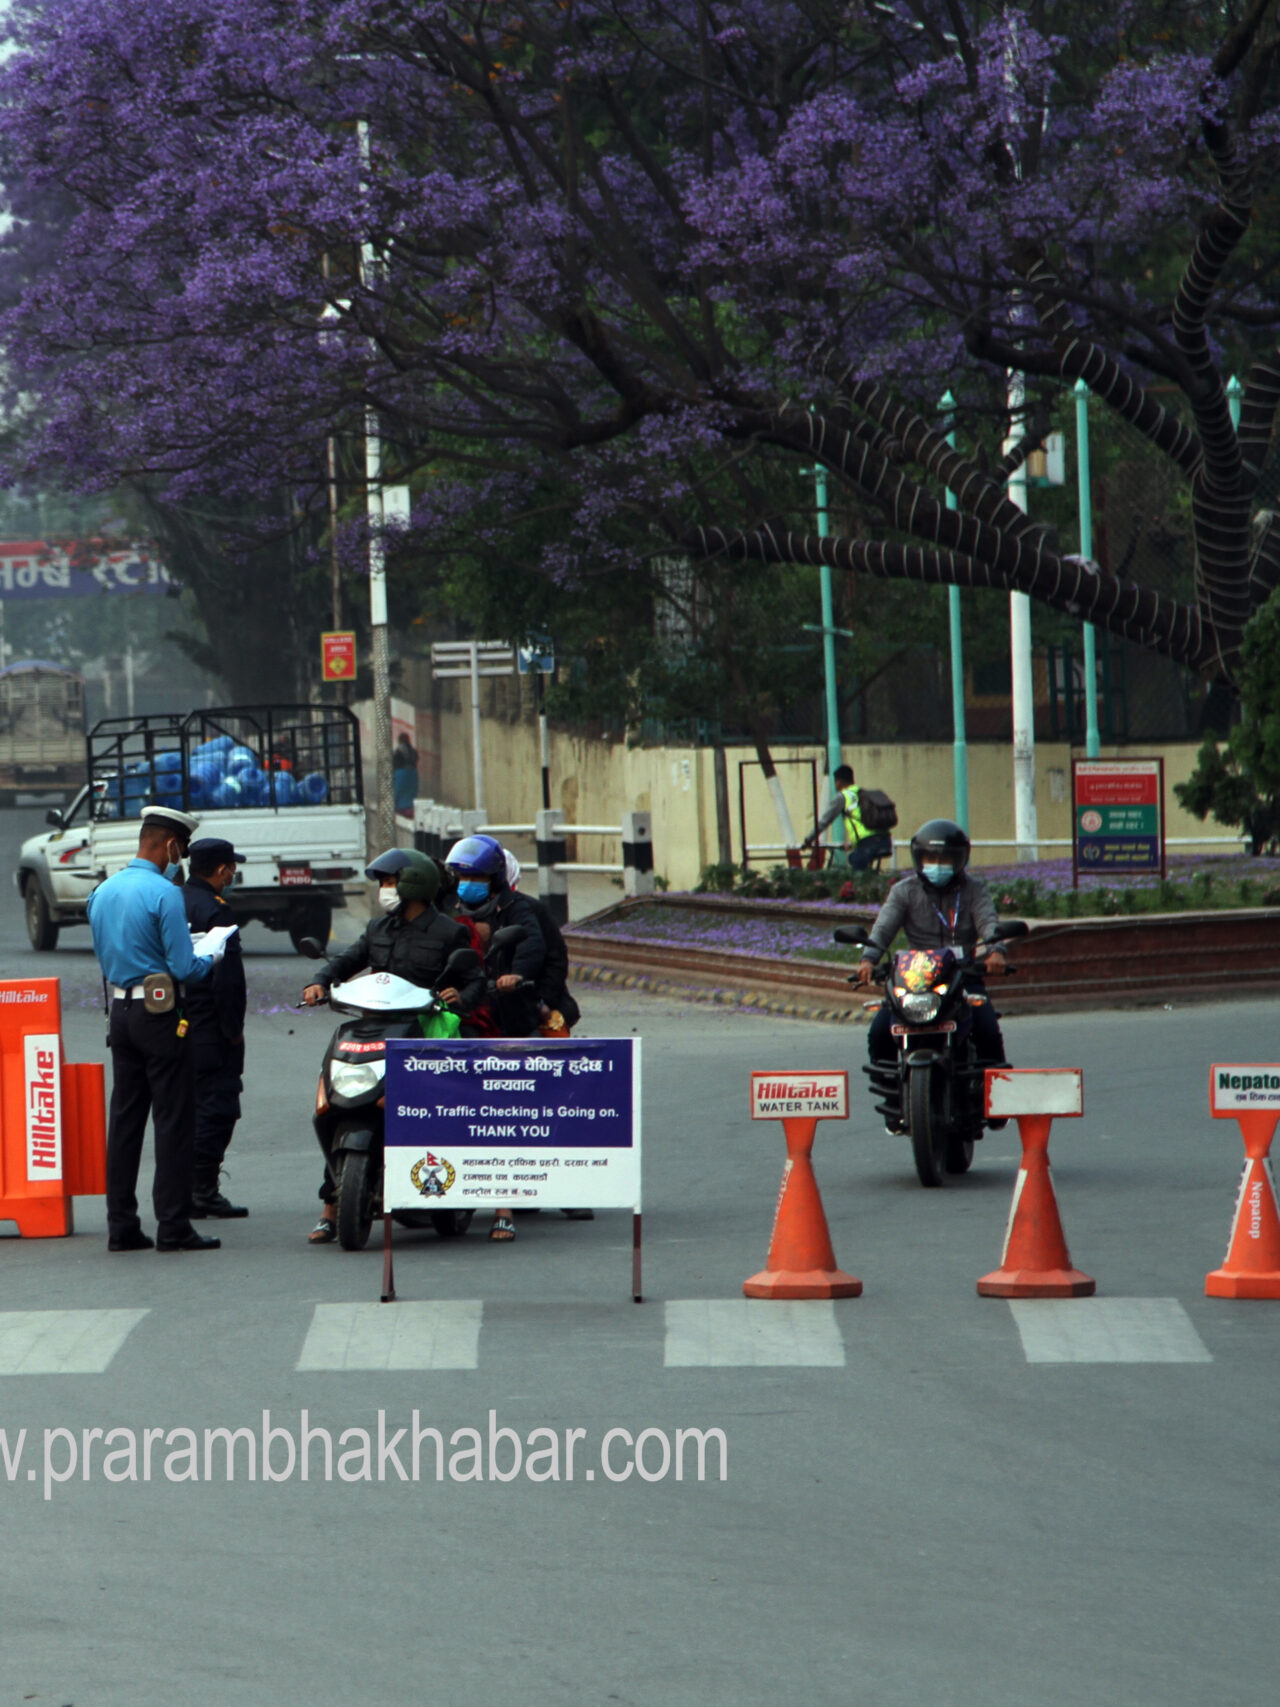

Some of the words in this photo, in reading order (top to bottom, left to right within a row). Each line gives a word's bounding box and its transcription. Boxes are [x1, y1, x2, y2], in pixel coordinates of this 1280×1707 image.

[483, 1079, 536, 1092] धन्यवाद
[1219, 1072, 1280, 1091] Nepato
[757, 1081, 838, 1099] Hilltake
[30, 1051, 56, 1169] Hilltake
[397, 1106, 431, 1119] Stop,
[435, 1105, 477, 1117] Traffic
[480, 1106, 538, 1119] Checking
[542, 1106, 553, 1117] is
[557, 1106, 595, 1119] Going
[599, 1108, 619, 1118] on.
[760, 1102, 802, 1112] WATER
[808, 1101, 839, 1112] TANK
[468, 1125, 516, 1137] THANK
[520, 1125, 550, 1137] YOU
[1248, 1181, 1263, 1239] Nepatop
